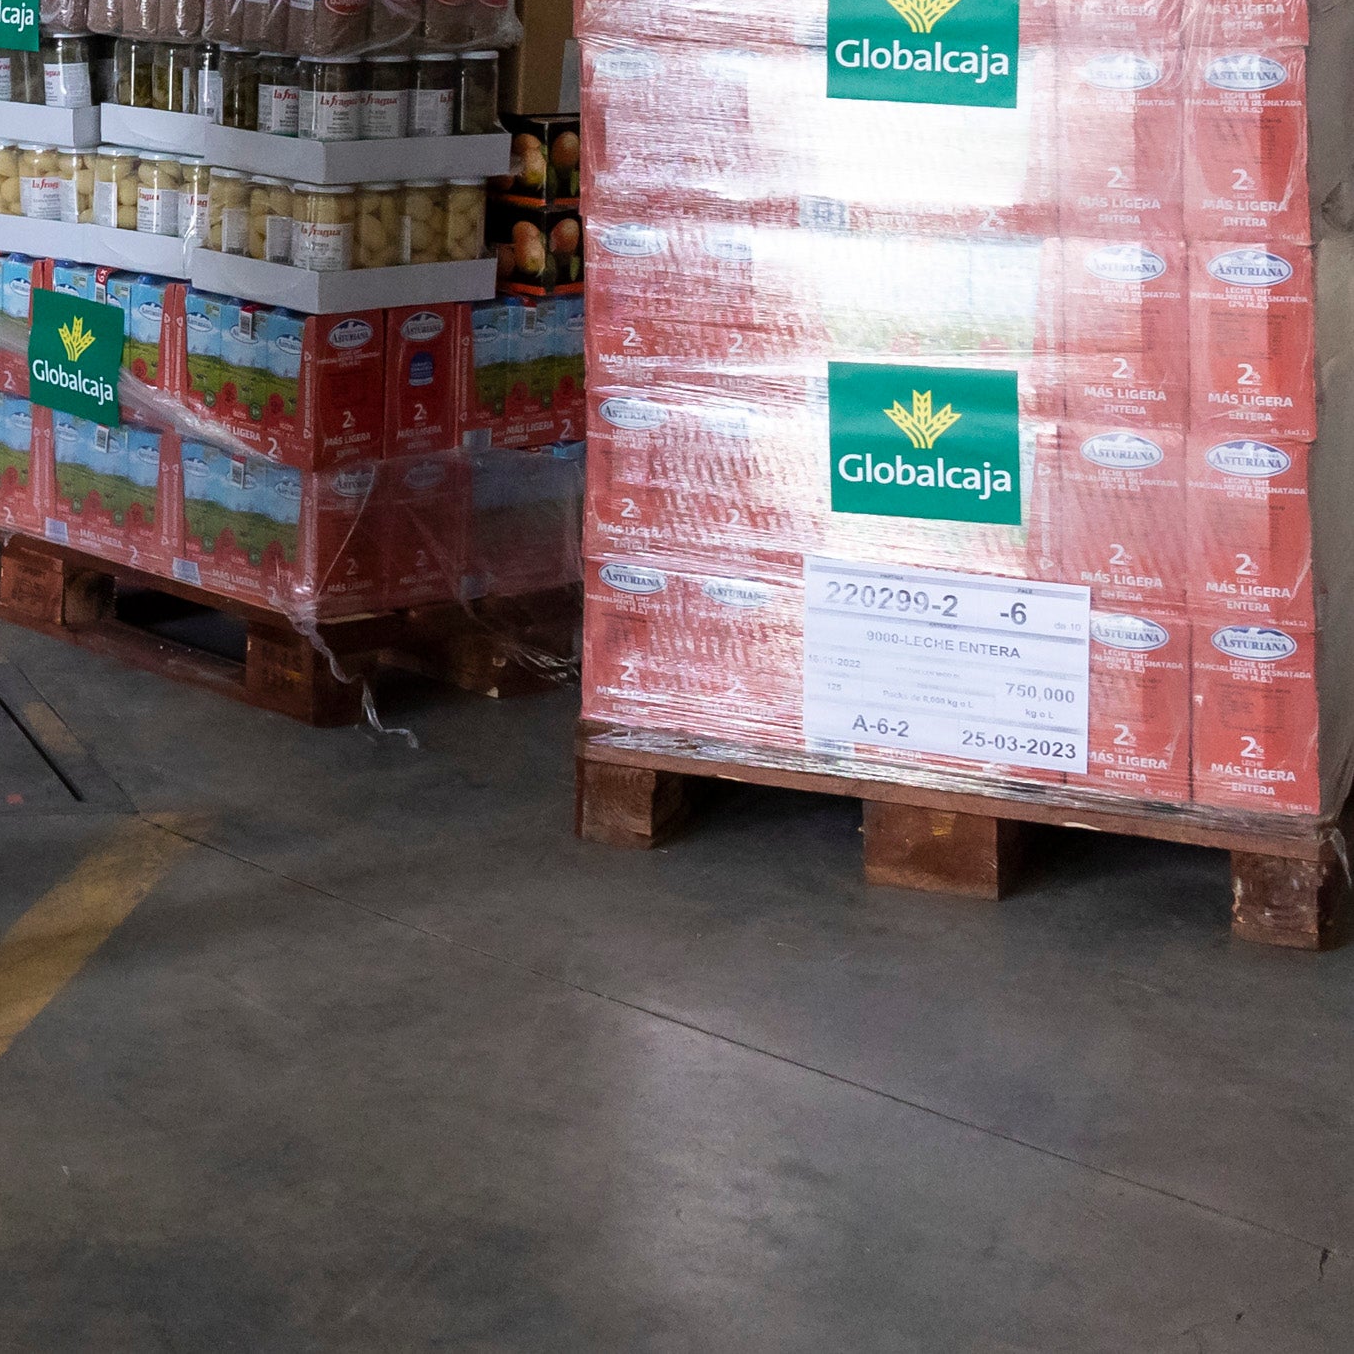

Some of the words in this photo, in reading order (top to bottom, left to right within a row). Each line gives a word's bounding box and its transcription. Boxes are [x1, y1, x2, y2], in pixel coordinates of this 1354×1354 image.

[1236, 3, 1285, 16] LIGERA
[835, 38, 1009, 84] Globalcaja
[1210, 68, 1279, 81] ASTURIANA
[1112, 198, 1161, 210] LIGERA
[1237, 201, 1288, 213] LIGERA
[1099, 214, 1141, 225] ENTERA
[1224, 216, 1268, 228] ENTERA
[1216, 262, 1284, 278] ASTURIANA
[598, 352, 624, 364] MÁS
[32, 359, 114, 405] Globalcaja
[1084, 386, 1114, 398] MÁS
[1117, 388, 1167, 402] LIGERA
[1208, 391, 1239, 405] MÁS
[1243, 395, 1293, 409] LIGERA
[1104, 404, 1147, 415] ENTERA
[1229, 411, 1273, 423] ENTERA
[232, 426, 261, 443] LIGERA
[344, 432, 371, 444] LIGERA
[1088, 445, 1155, 461] ASTURIANA
[1213, 452, 1282, 469] ASTURIANA
[838, 452, 1012, 500] Globalcaja
[604, 569, 661, 588] ASTURIANA
[1081, 570, 1111, 584] MÁS
[1114, 575, 1163, 588] LIGERA
[1206, 581, 1237, 594] MÁS
[1240, 585, 1291, 599] LIGERA
[826, 580, 960, 619] 220299-2
[1226, 599, 1271, 613] ENTERA
[1054, 621, 1068, 631] de
[1070, 622, 1082, 632] 10
[1093, 625, 1161, 643] ASTURIANA
[866, 629, 955, 652] 9000-LECHE
[959, 640, 1021, 660] ENTERA
[1220, 636, 1288, 653] ASTURIANA
[1229, 659, 1257, 669] LECHE
[1258, 662, 1276, 670] UHT
[1260, 669, 1312, 679] DESNATADA
[1005, 682, 1076, 704] 750,000
[1025, 707, 1037, 720] kg
[1048, 710, 1055, 720] L
[852, 714, 910, 738] A-6-2
[962, 729, 1077, 760] 25-03-2023
[1118, 756, 1168, 770] LIGERA
[1105, 770, 1147, 783] ENTERA
[1211, 763, 1241, 777] MÁS
[1246, 767, 1296, 782] LIGERA
[1231, 783, 1276, 796] ENTERA
